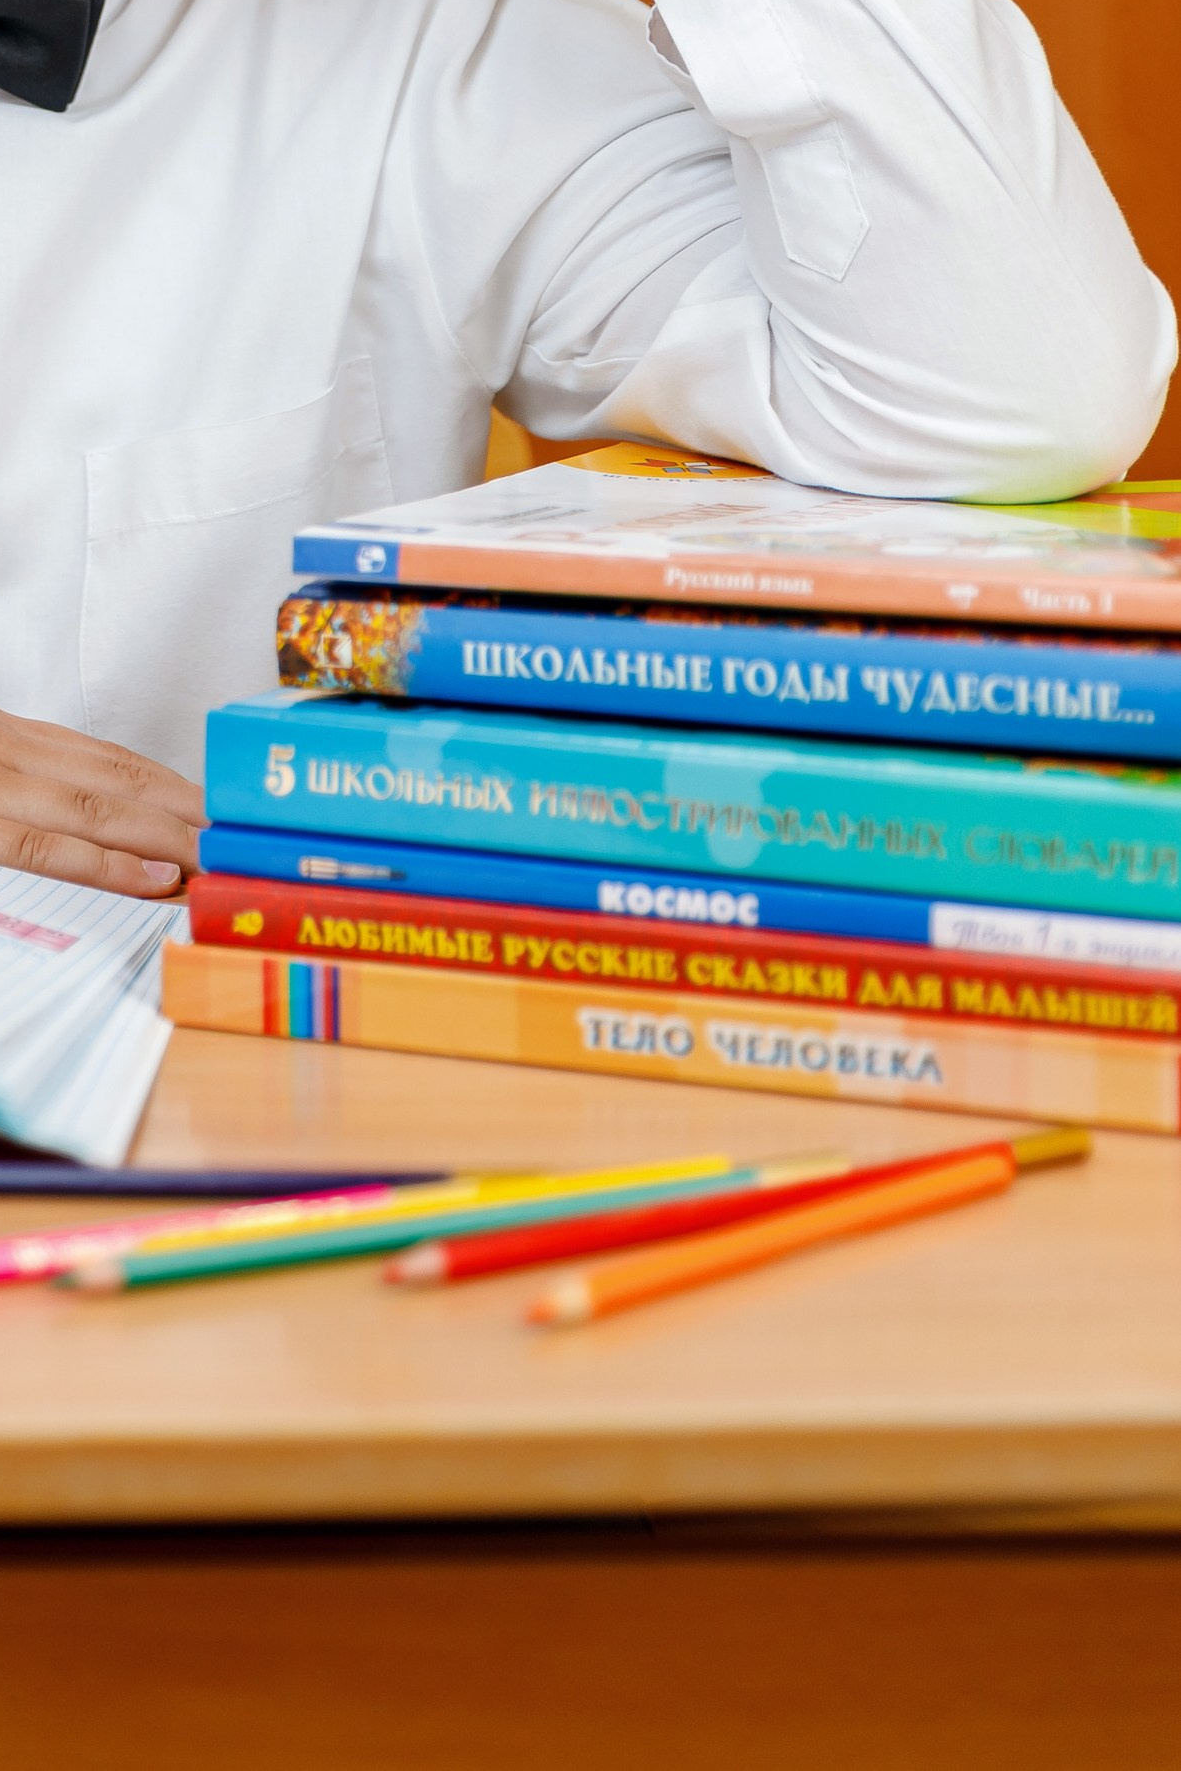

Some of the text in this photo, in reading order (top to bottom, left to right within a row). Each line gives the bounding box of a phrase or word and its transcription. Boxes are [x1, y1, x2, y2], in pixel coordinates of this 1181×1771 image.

[664, 566, 754, 592] Русский
[758, 575, 814, 596] язык
[1023, 586, 1091, 614] Часть
[462, 639, 1156, 725] ШКОЛЬНЫЕ ГОДЫ ЧУДЕСНЫЕ...
[264, 743, 297, 798] 5
[307, 758, 515, 814] ШКОЛЬНЫХ
[528, 778, 948, 861] ИЛЛЮСТРИРОВАННЫХ
[597, 880, 760, 927] КОСМОС
[297, 914, 1179, 1034] ЛЮБИМЫЕ РУССКИЕ СКАЗКИ ДЛЯ МАЛЫШЕЙ
[583, 1012, 944, 1085] ТЕЛО ЧЕЛОВЕКА
